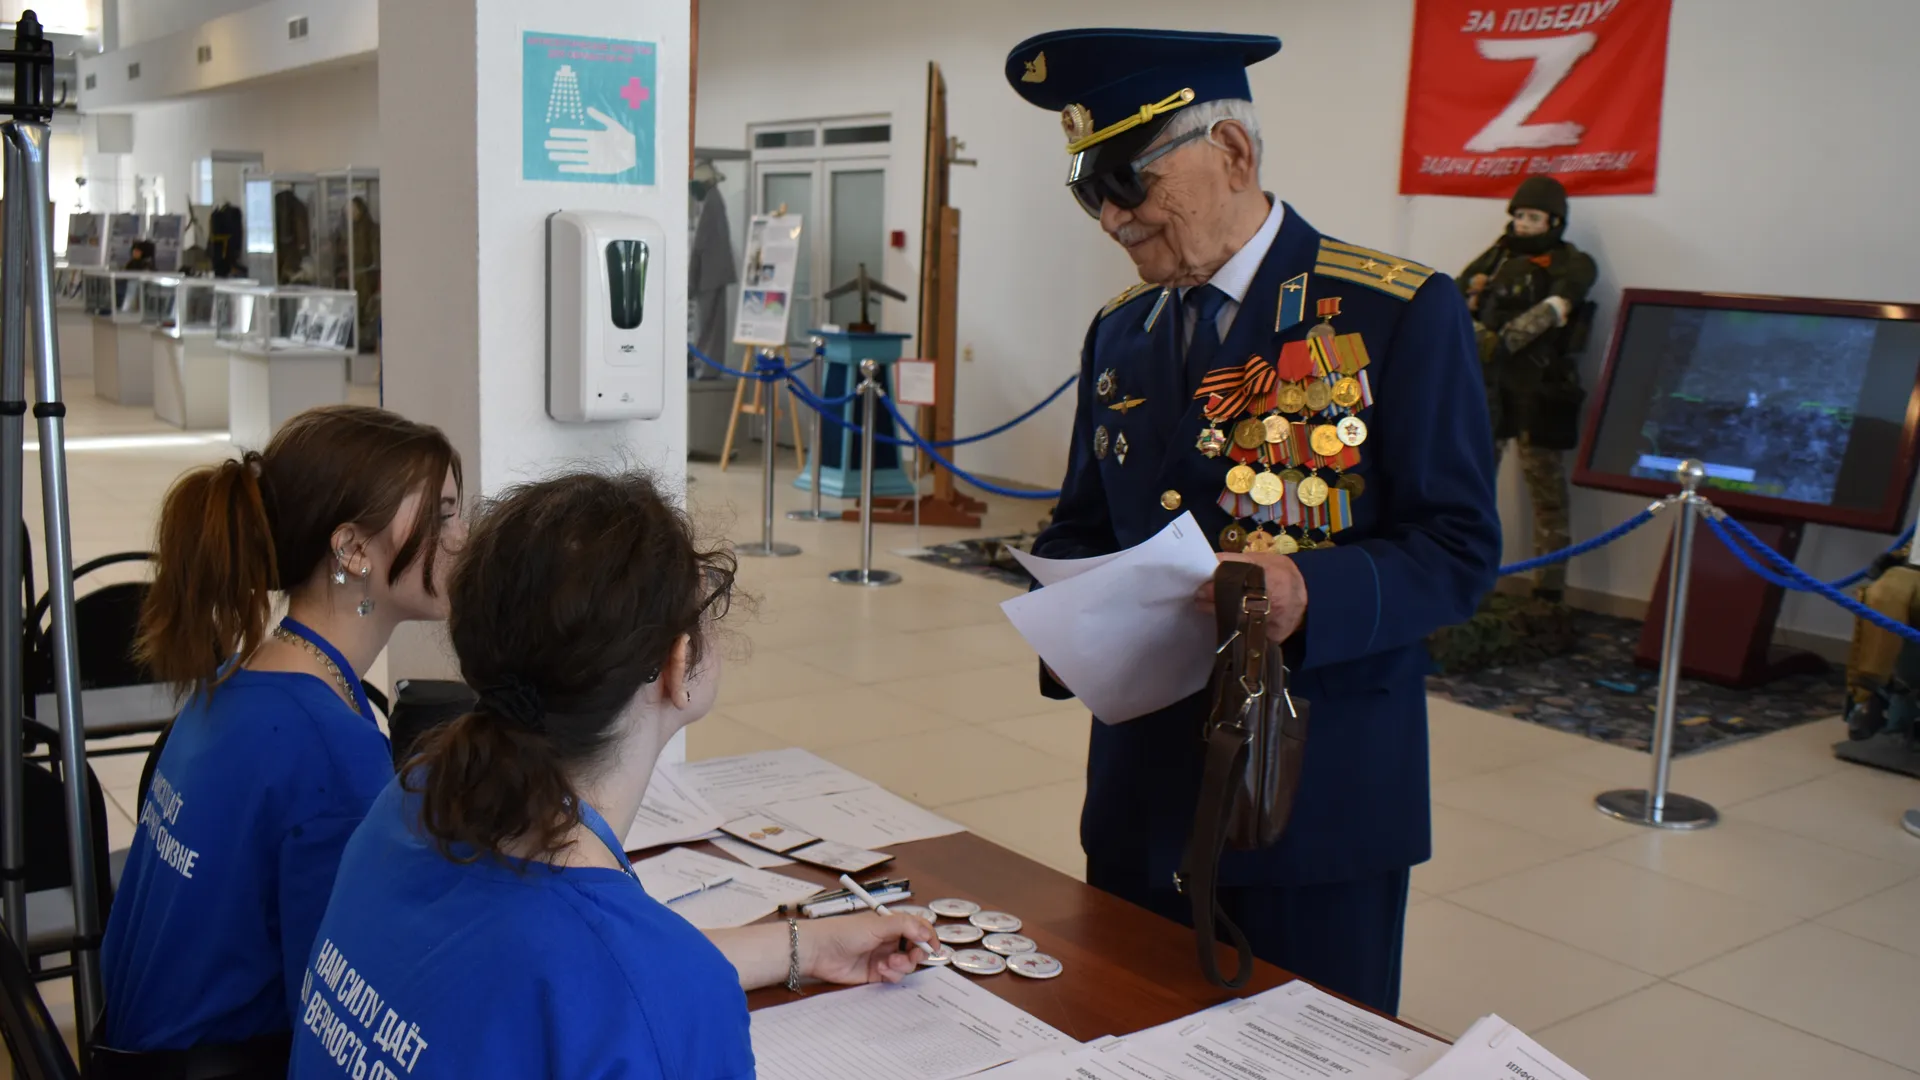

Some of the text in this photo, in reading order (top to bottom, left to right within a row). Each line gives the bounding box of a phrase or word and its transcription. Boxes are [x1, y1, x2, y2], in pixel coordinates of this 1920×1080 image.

[1461, 0, 1619, 32] ЗА ПОБЕДУ!
[1462, 31, 1597, 153] Z
[1419, 156, 1474, 175] ЗАДАЧА
[1472, 156, 1527, 176] БУДЕТ
[303, 990, 367, 1080] ВЕРНОСТЬ
[315, 938, 429, 1073] НАМ СИЛУ ДАЁТ
